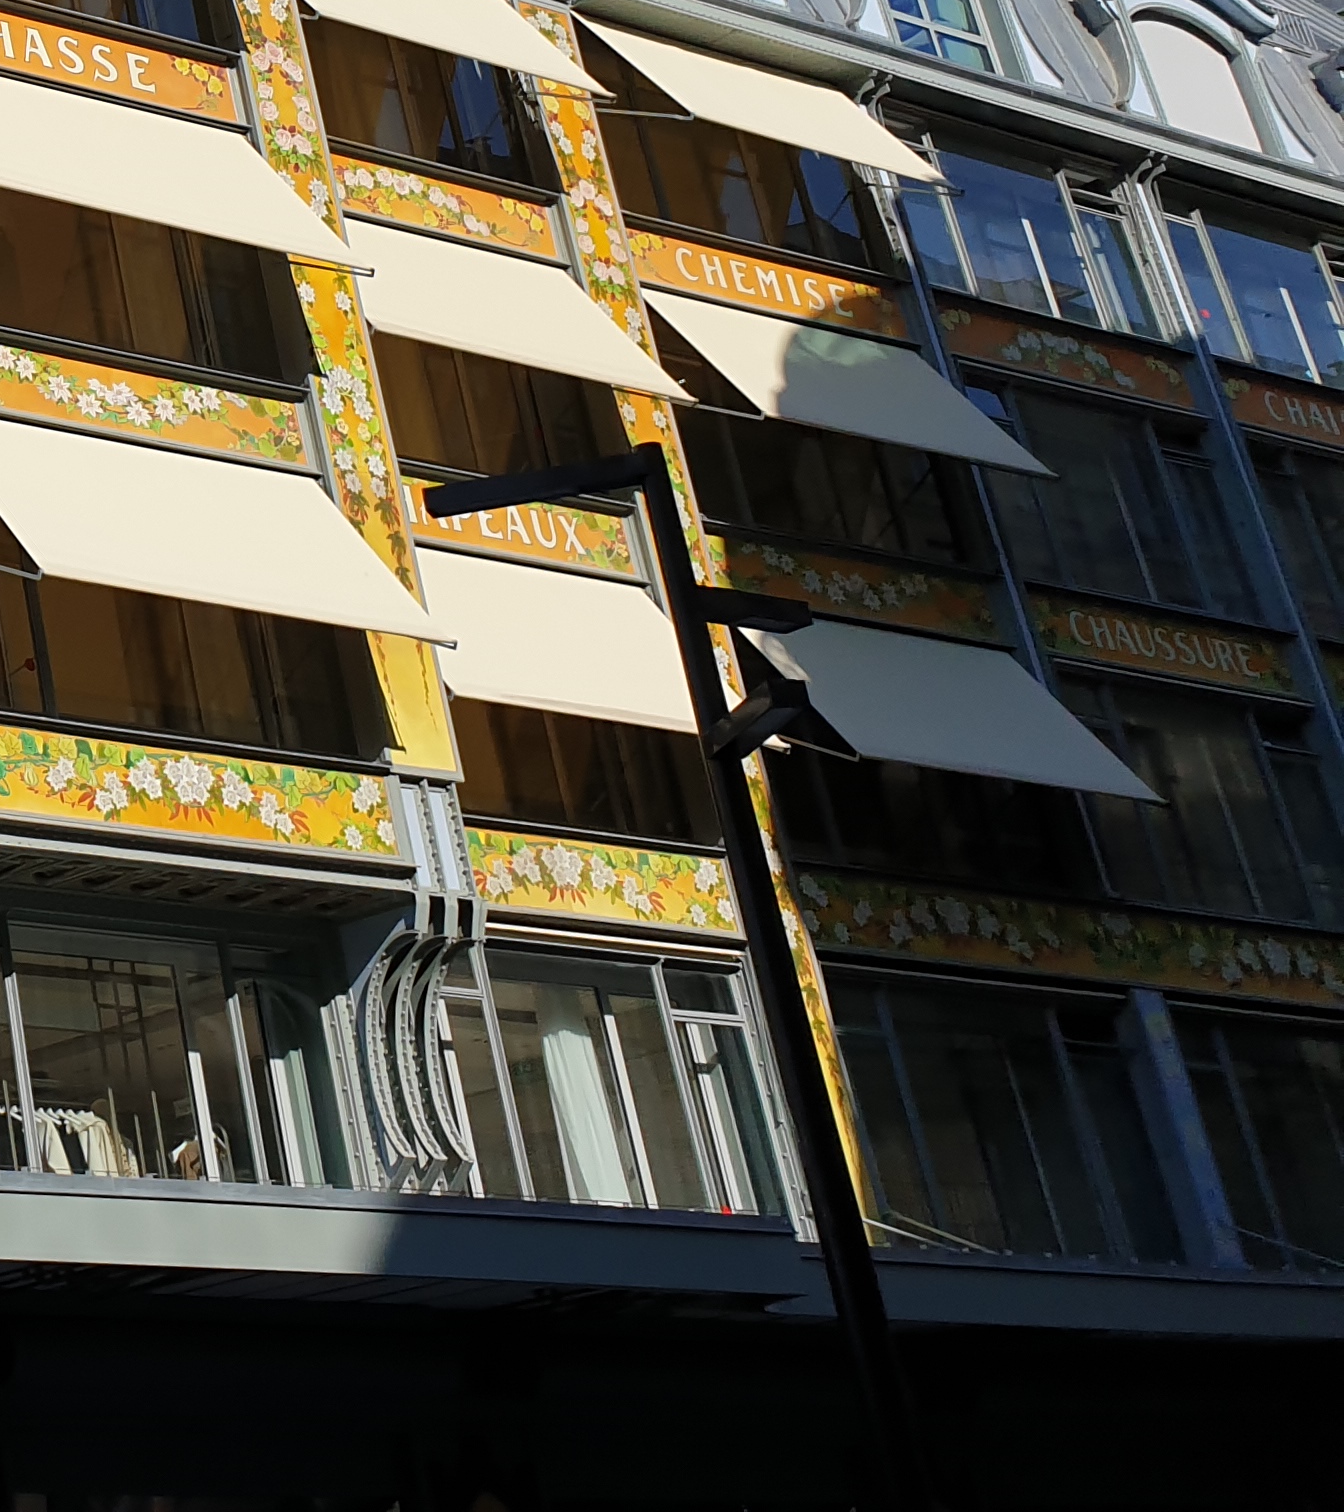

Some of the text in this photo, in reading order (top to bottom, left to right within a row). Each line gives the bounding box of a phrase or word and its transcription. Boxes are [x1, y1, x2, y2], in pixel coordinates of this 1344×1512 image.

[674, 247, 854, 318] CHEMISE
[1264, 390, 1344, 436] CHAI
[1069, 609, 1261, 678] CHAUSSURE
